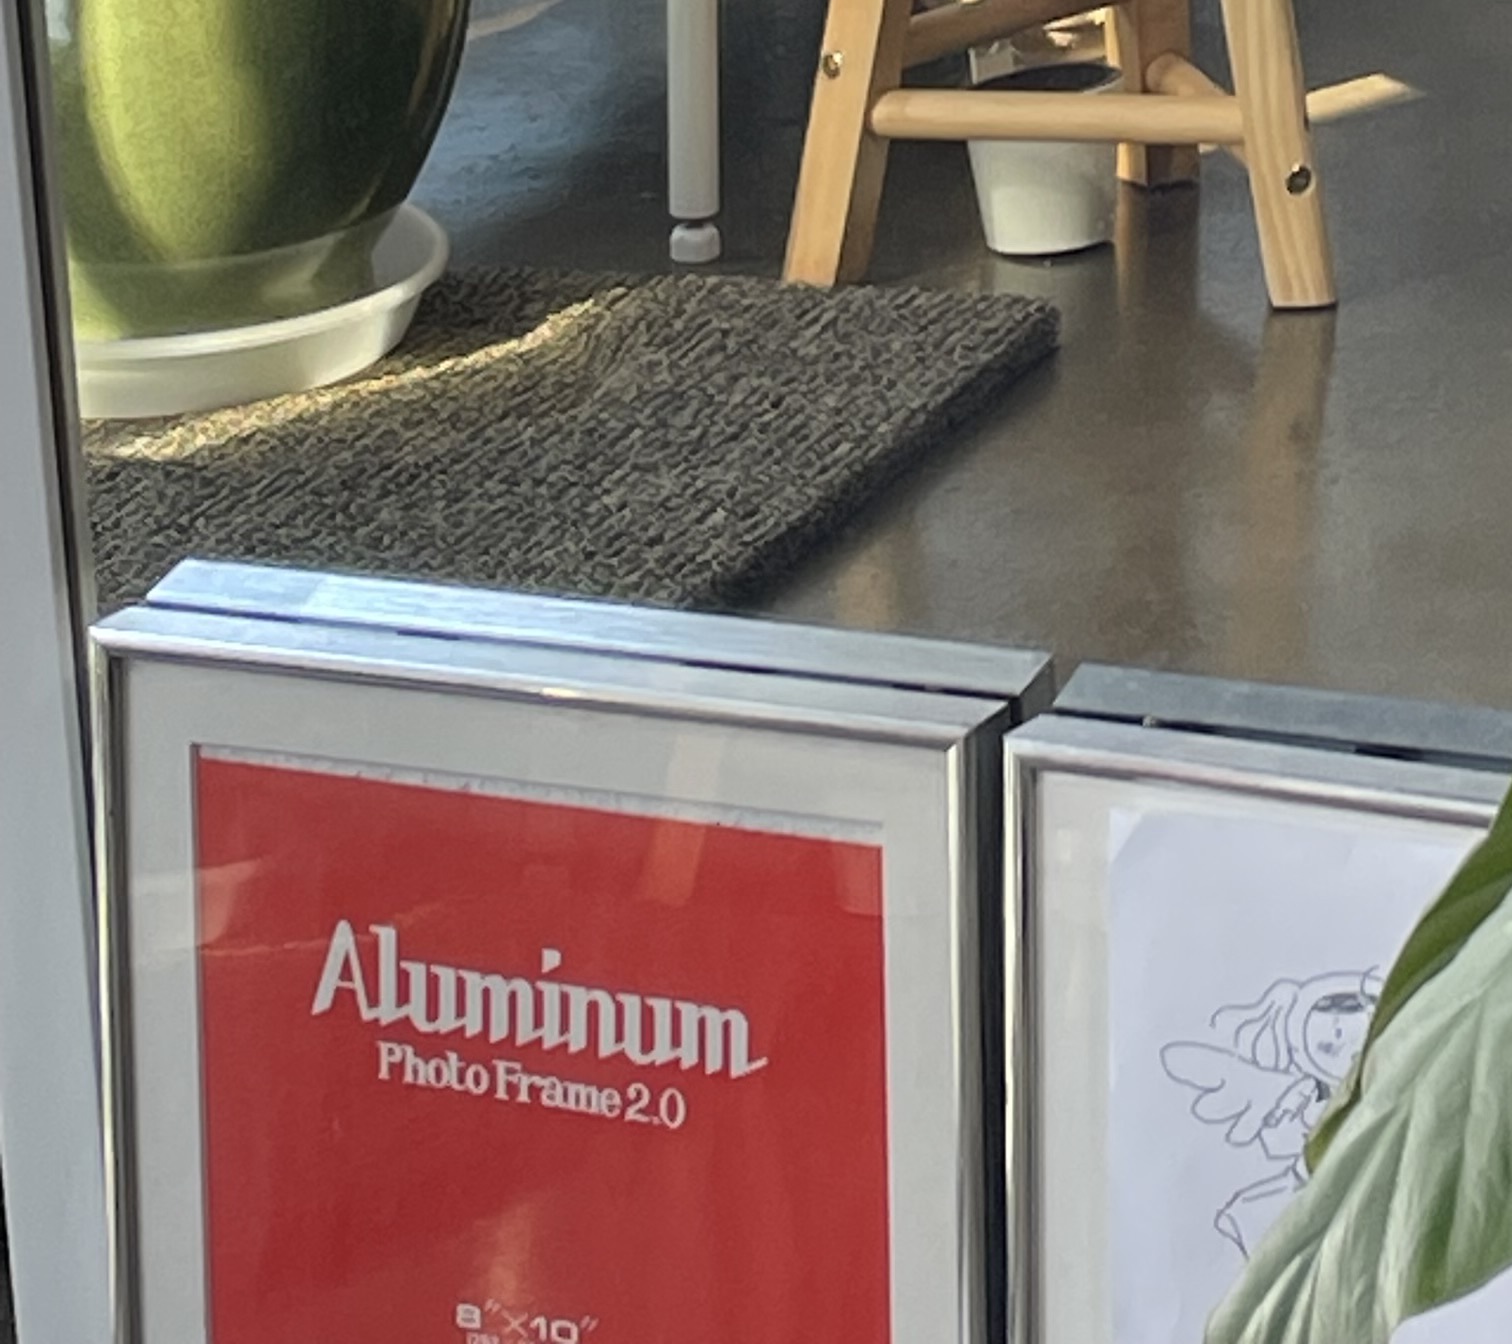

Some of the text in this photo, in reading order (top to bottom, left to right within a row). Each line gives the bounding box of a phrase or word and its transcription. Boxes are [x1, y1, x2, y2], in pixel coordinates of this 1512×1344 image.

[311, 918, 768, 1080] Aluminum
[376, 1039, 687, 1131] Photo Frame 2.0
